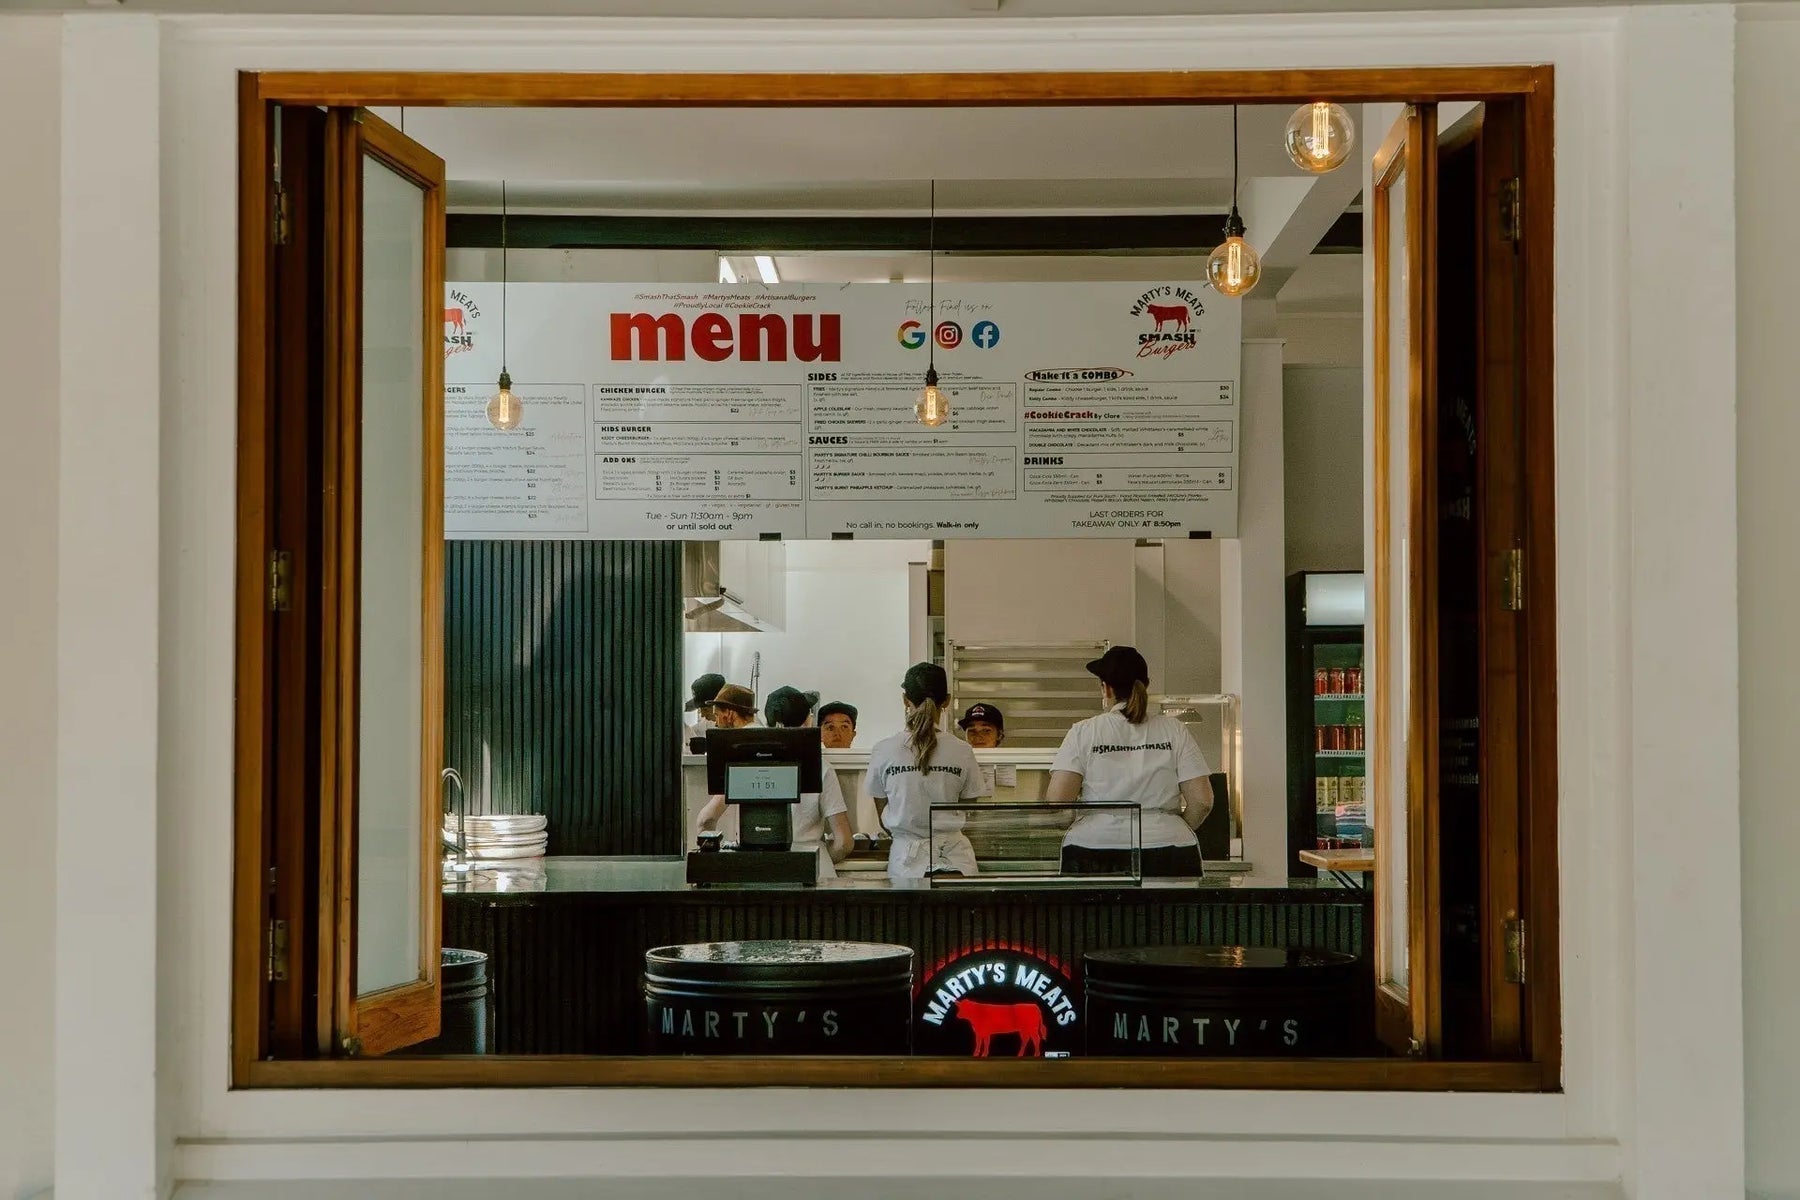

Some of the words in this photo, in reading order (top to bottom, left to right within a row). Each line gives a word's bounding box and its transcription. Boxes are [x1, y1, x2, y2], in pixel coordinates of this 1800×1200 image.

[450, 290, 480, 319] MEATS
[1130, 286, 1171, 316] MARTY'S
[1175, 287, 1204, 316] MEATS
[445, 336, 472, 346] ASH
[610, 312, 840, 362] menu
[1138, 334, 1195, 345] SMASH
[1136, 340, 1196, 360] Burgers
[808, 373, 837, 381] SIDES
[1032, 372, 1059, 380] Make
[1082, 372, 1118, 380] COMBO
[1024, 411, 1093, 419] #CookieCrack
[732, 512, 753, 520] 9pm
[1092, 742, 1172, 754] #SMASHTHATSMASH
[922, 963, 1006, 1026] MARTY'S
[1015, 964, 1077, 1026] MEATS
[662, 1007, 839, 1038] MARTY'S
[1114, 1012, 1298, 1046] MARTY'S
